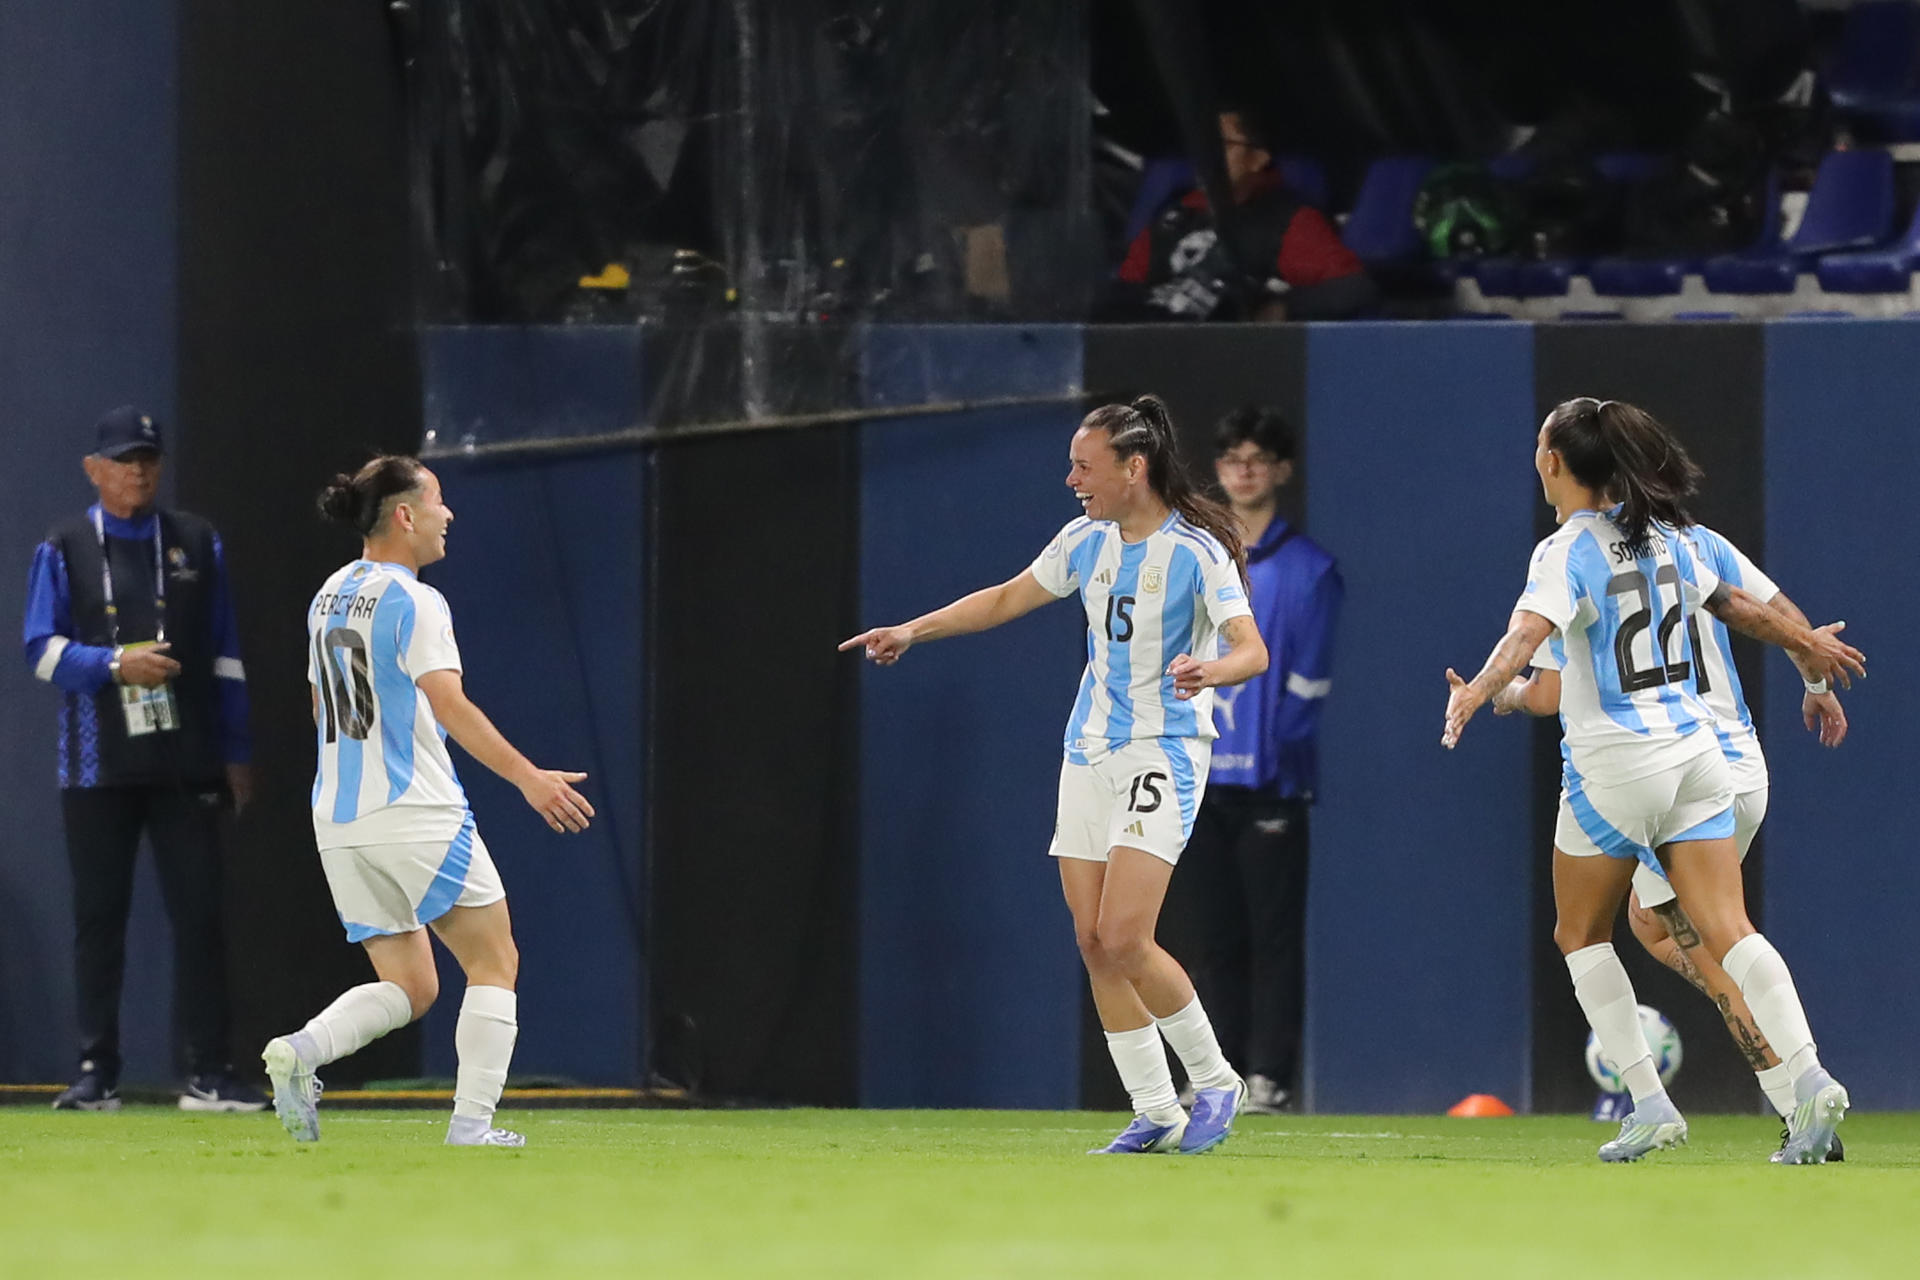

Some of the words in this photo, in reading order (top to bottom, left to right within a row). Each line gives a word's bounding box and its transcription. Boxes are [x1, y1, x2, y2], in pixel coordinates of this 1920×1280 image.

[314, 593, 378, 619] PEREYRA
[1105, 595, 1136, 643] 15
[1606, 564, 1691, 693] 22
[316, 627, 375, 744] 10
[1127, 771, 1167, 813] 15
